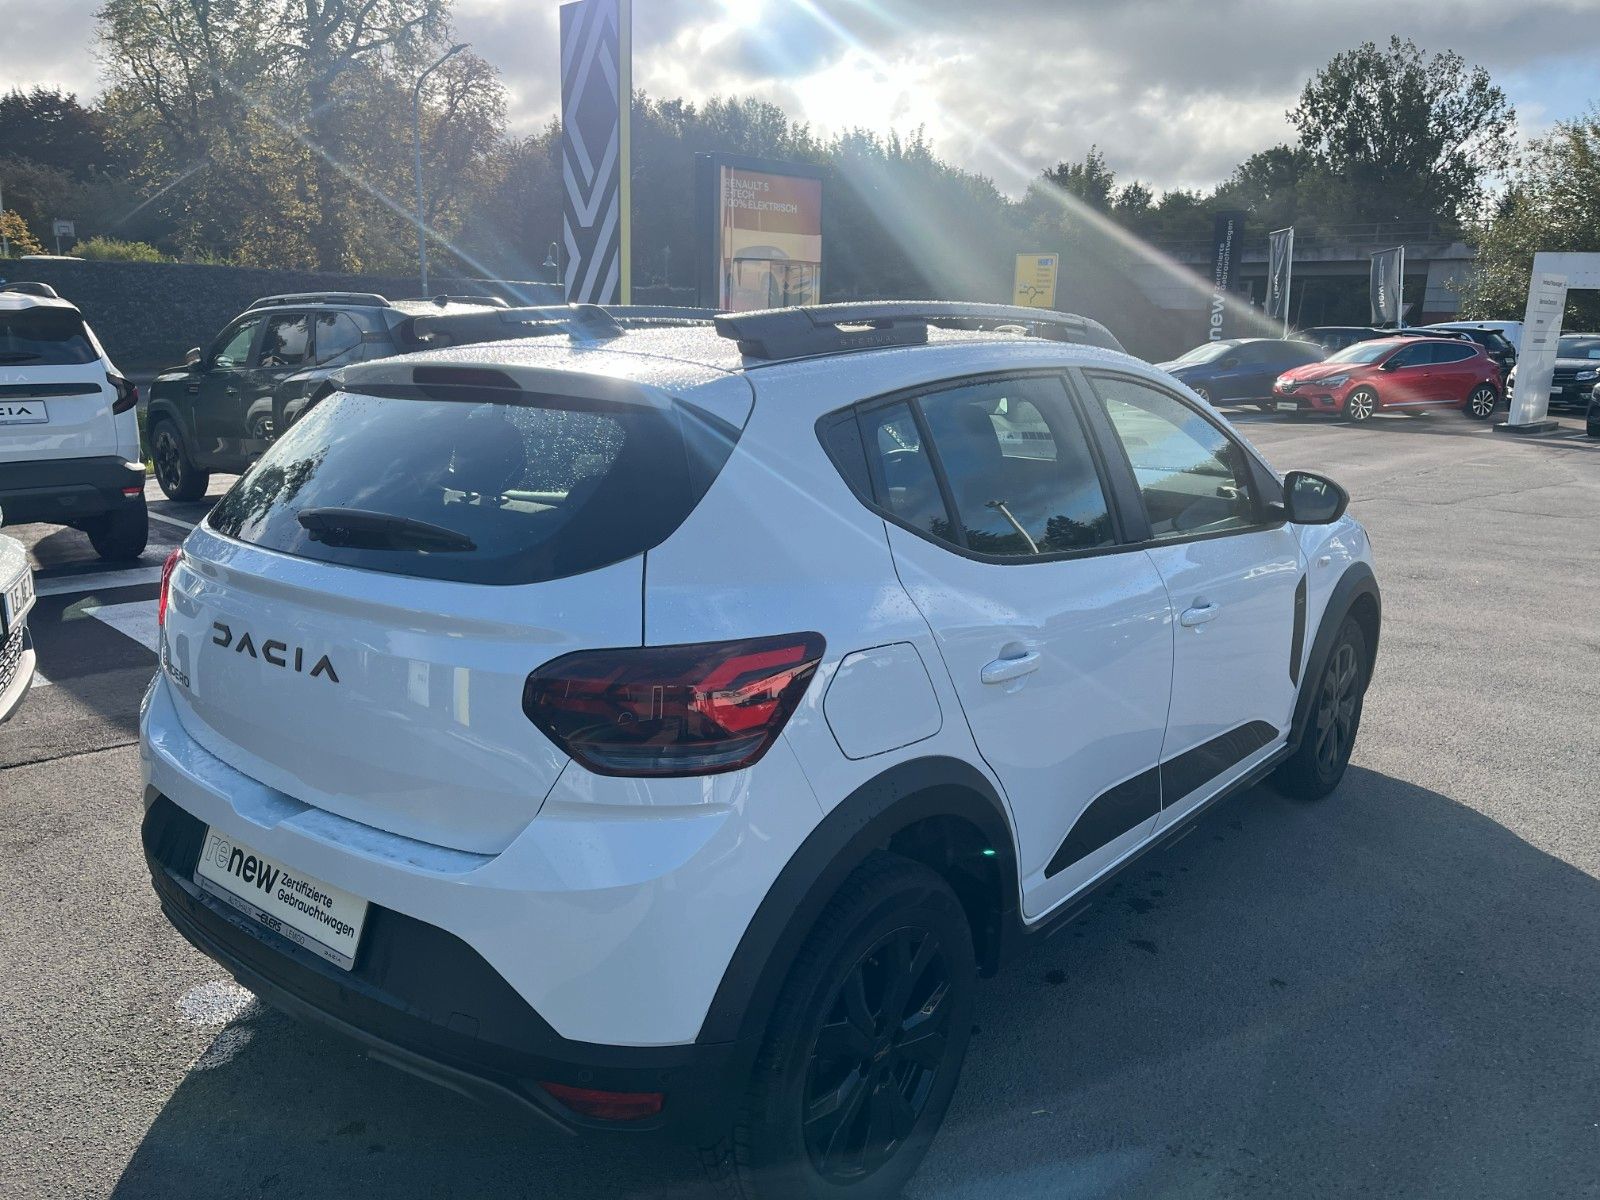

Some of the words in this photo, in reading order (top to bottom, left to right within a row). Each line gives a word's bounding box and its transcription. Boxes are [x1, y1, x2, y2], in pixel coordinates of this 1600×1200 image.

[748, 200, 797, 213] ELEKTRISCH
[212, 621, 340, 683] DACIA
[280, 872, 333, 908] Zertifizierte
[277, 888, 355, 938] Gebrauchtwagen
